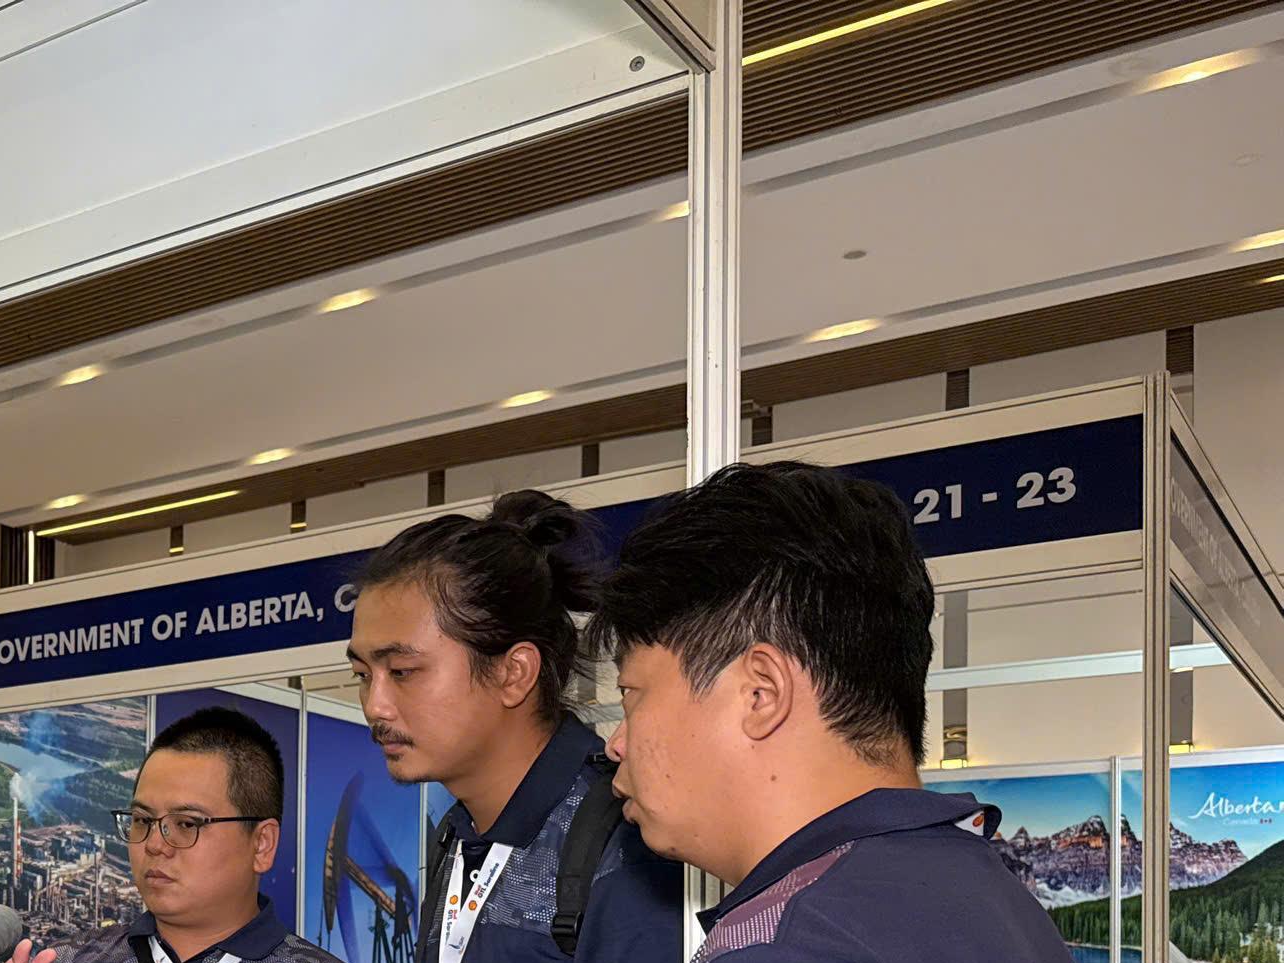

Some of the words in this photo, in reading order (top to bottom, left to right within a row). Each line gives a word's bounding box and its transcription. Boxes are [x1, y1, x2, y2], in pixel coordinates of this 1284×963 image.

[913, 484, 963, 524] 21
[982, 492, 998, 503] -
[1016, 466, 1077, 509] 23
[151, 613, 188, 641] OF
[195, 590, 324, 635] ALBERTA,
[1188, 791, 1279, 819] Alberta
